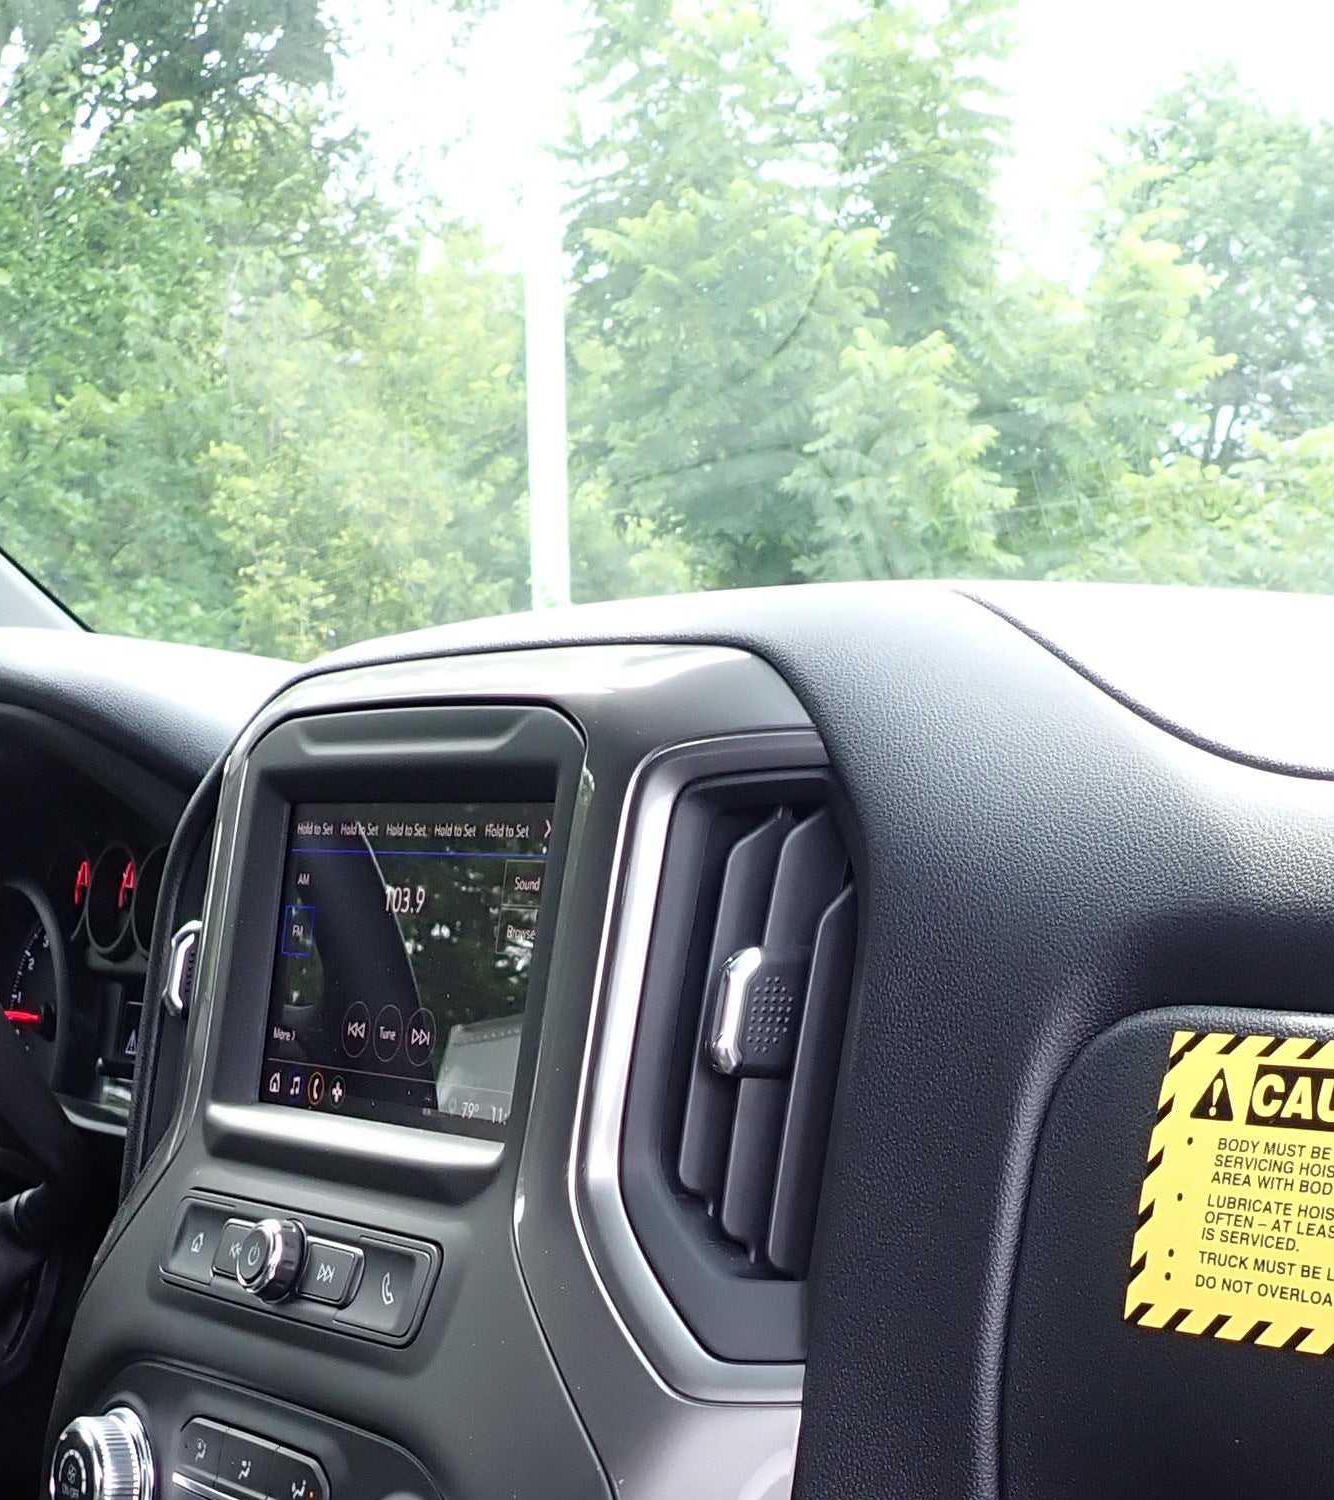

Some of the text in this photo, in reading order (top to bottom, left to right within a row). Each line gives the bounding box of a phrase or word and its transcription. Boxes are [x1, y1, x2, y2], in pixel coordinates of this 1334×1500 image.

[297, 822, 313, 835] Hold
[322, 822, 334, 835] Set
[386, 822, 404, 836] Hold
[414, 823, 426, 837] Set
[434, 823, 453, 837] Hold
[463, 823, 476, 837] Set
[485, 823, 504, 838] Hold
[515, 824, 529, 838] Set
[297, 873, 310, 885] AM
[514, 876, 541, 891] Sound
[385, 886, 426, 913] 103.9
[292, 924, 304, 938] FM
[507, 925, 536, 940] Browse
[28, 957, 35, 971] 2
[1217, 1138, 1260, 1153] BODY
[1263, 1142, 1306, 1157] MUST
[1311, 1146, 1332, 1160] BE
[1214, 1154, 1294, 1174] SERVICING
[1211, 1172, 1251, 1187] AREA
[1258, 1176, 1294, 1191] WITH
[1207, 1194, 1293, 1216] LUBRICATE
[1205, 1212, 1253, 1228] OFTEN
[1271, 1219, 1292, 1233] AT
[1201, 1228, 1299, 1252] IS SERVICED.
[1199, 1251, 1248, 1270] TRUCK
[1253, 1258, 1296, 1276] MUST
[1301, 1265, 1322, 1280] BE
[1195, 1275, 1216, 1289] DO
[1221, 1278, 1253, 1294] NOT
